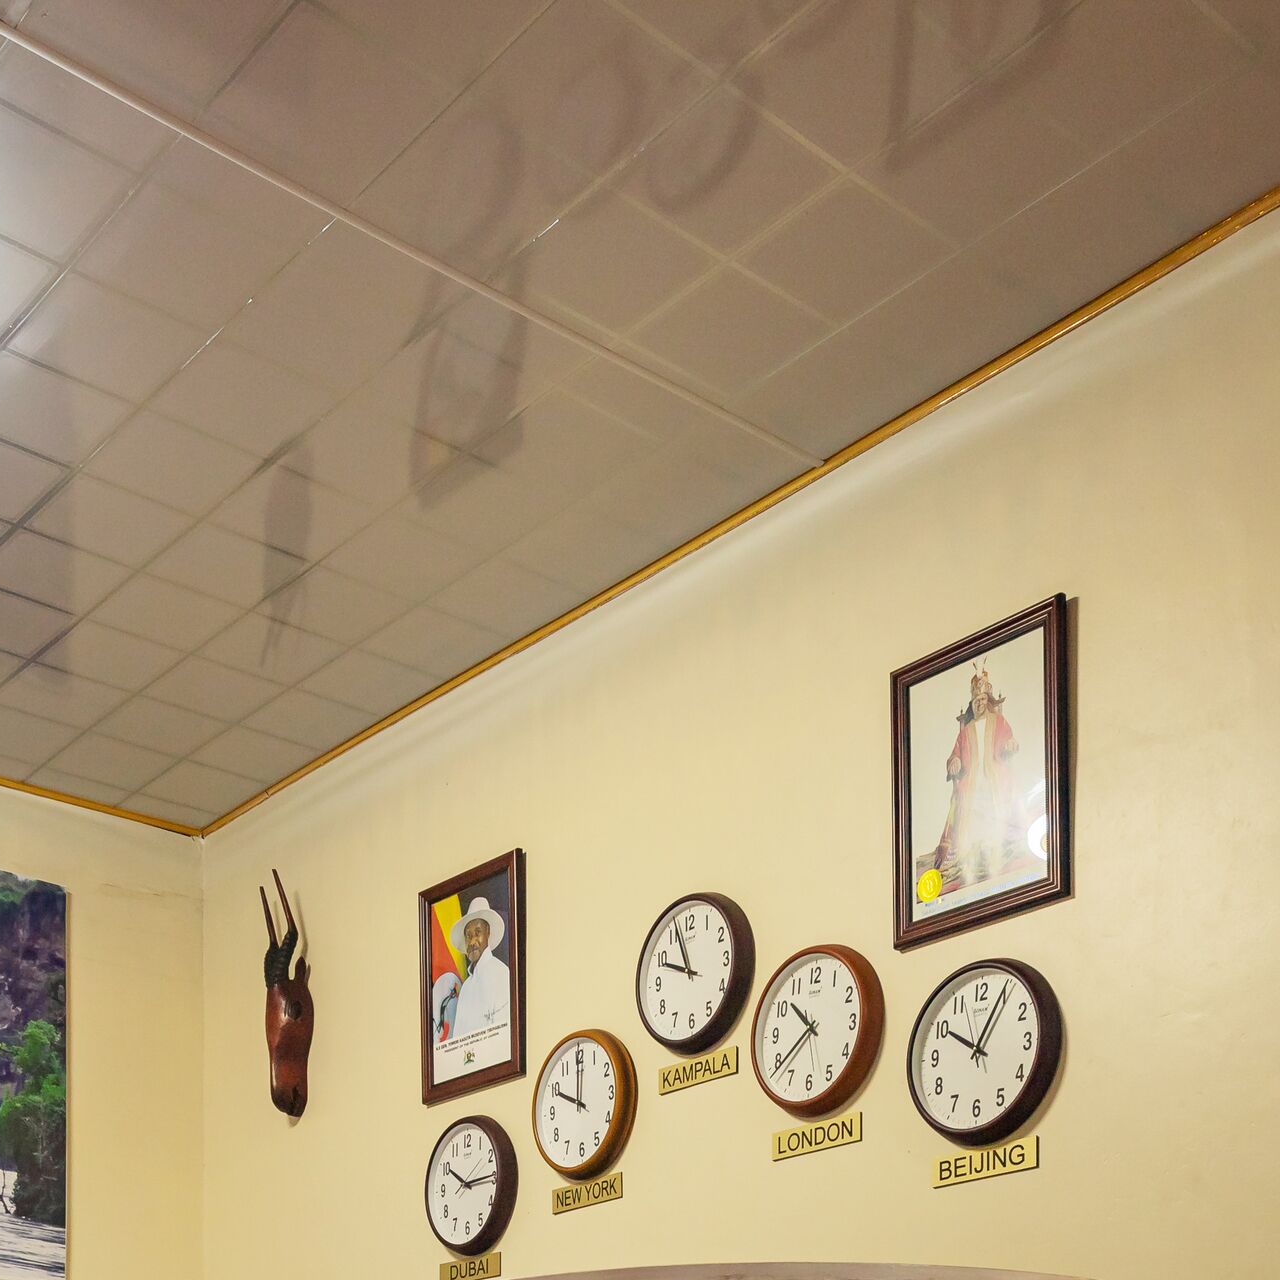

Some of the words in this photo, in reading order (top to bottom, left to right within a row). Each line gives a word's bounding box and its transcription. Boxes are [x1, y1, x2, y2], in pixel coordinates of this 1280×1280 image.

[685, 915, 695, 932] 12
[705, 915, 708, 930] 1
[718, 927, 724, 943] 2
[657, 950, 667, 967] 10
[722, 951, 729, 967] 3
[655, 976, 661, 992] 9
[810, 966, 821, 985] 12
[833, 970, 836, 987] 1
[719, 978, 726, 995] 4
[792, 978, 801, 996] 11
[845, 986, 853, 1004] 2
[975, 982, 988, 1002] 12
[660, 999, 666, 1015] 8
[706, 1001, 712, 1017] 5
[777, 1000, 787, 1018] 10
[953, 995, 964, 1015] 11
[1018, 1002, 1027, 1022] 2
[672, 1012, 678, 1028] 7
[689, 1013, 695, 1029] 6
[848, 1013, 856, 1031] 3
[772, 1027, 779, 1044] 9
[936, 1020, 949, 1039] 10
[1023, 1031, 1032, 1051] 3
[593, 1050, 595, 1065] 1
[841, 1042, 849, 1060] 4
[931, 1049, 939, 1068] 9
[561, 1060, 569, 1077] 11
[775, 1053, 781, 1069] 8
[604, 1062, 609, 1078] 2
[662, 1053, 730, 1089] KAMPALA
[788, 1069, 795, 1086] 7
[825, 1064, 833, 1082] 5
[1015, 1064, 1024, 1082] 4
[551, 1082, 560, 1097] 10
[805, 1074, 812, 1091] 6
[935, 1077, 943, 1095] 8
[608, 1085, 614, 1100] 3
[996, 1088, 1005, 1106] 5
[951, 1094, 959, 1113] 7
[972, 1099, 980, 1117] 6
[550, 1106, 555, 1121] 9
[605, 1110, 611, 1125] 4
[463, 1133, 472, 1148] 12
[479, 1136, 482, 1150] 1
[554, 1128, 559, 1142] 8
[594, 1131, 599, 1147] 5
[778, 1118, 853, 1154] LONDON
[451, 1143, 459, 1158] 11
[488, 1148, 493, 1163] 2
[565, 1140, 570, 1155] 7
[579, 1142, 585, 1157] 6
[442, 1162, 450, 1176] 10
[939, 1144, 1025, 1181] BEIJING
[440, 1184, 446, 1197] 9
[556, 1187, 583, 1209] NEW
[584, 1178, 617, 1201] YORK
[488, 1194, 494, 1207] 4
[443, 1205, 449, 1218] 8
[478, 1213, 483, 1227] 5
[452, 1217, 458, 1232] 7
[465, 1221, 470, 1235] 6
[450, 1259, 489, 1280] DUBAI
